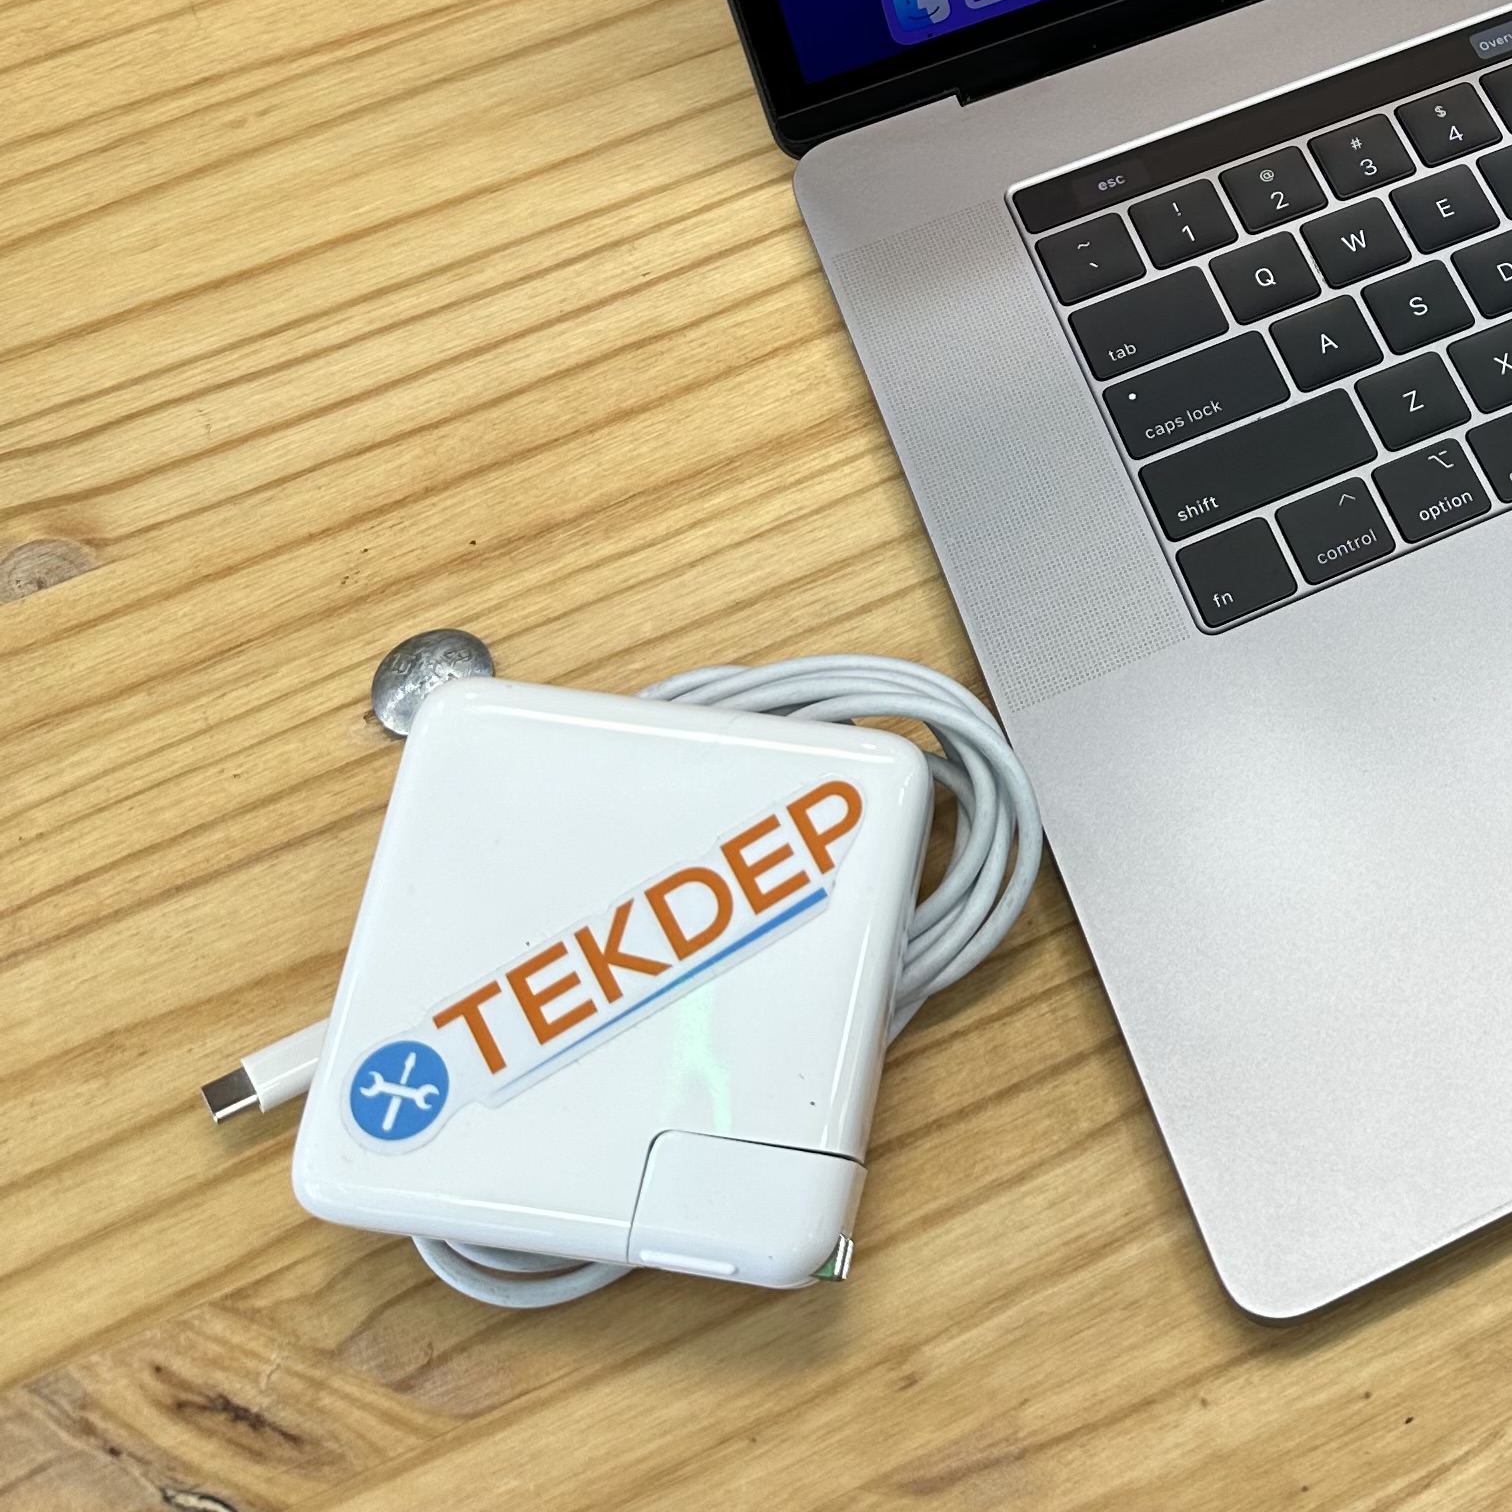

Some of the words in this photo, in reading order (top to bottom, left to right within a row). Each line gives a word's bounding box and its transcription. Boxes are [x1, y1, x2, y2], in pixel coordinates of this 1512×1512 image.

[1098, 175, 1125, 191] esc
[1108, 344, 1137, 361] tab
[1145, 417, 1185, 439] caps
[1186, 401, 1222, 422] lock
[1177, 497, 1219, 522] shift
[1419, 492, 1473, 521] option
[1317, 529, 1377, 564] control
[1213, 592, 1233, 608] fn
[434, 781, 862, 1075] TEKDEP
